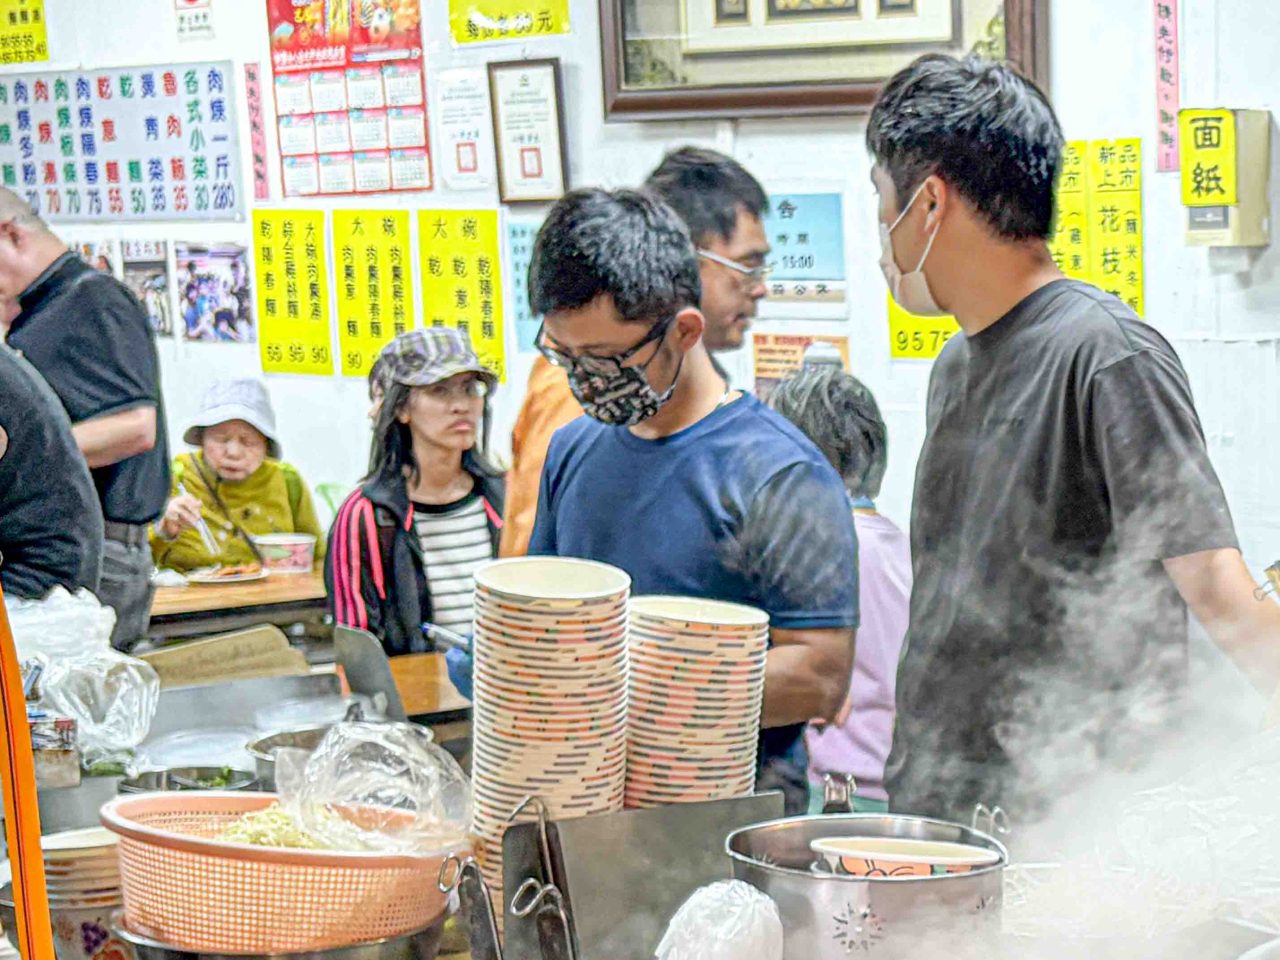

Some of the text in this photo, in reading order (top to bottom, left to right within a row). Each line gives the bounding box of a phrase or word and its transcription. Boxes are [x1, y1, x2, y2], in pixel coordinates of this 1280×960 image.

[1189, 116, 1226, 199] 面紙
[1098, 205, 1122, 300] 花枝
[897, 330, 925, 351] 95
